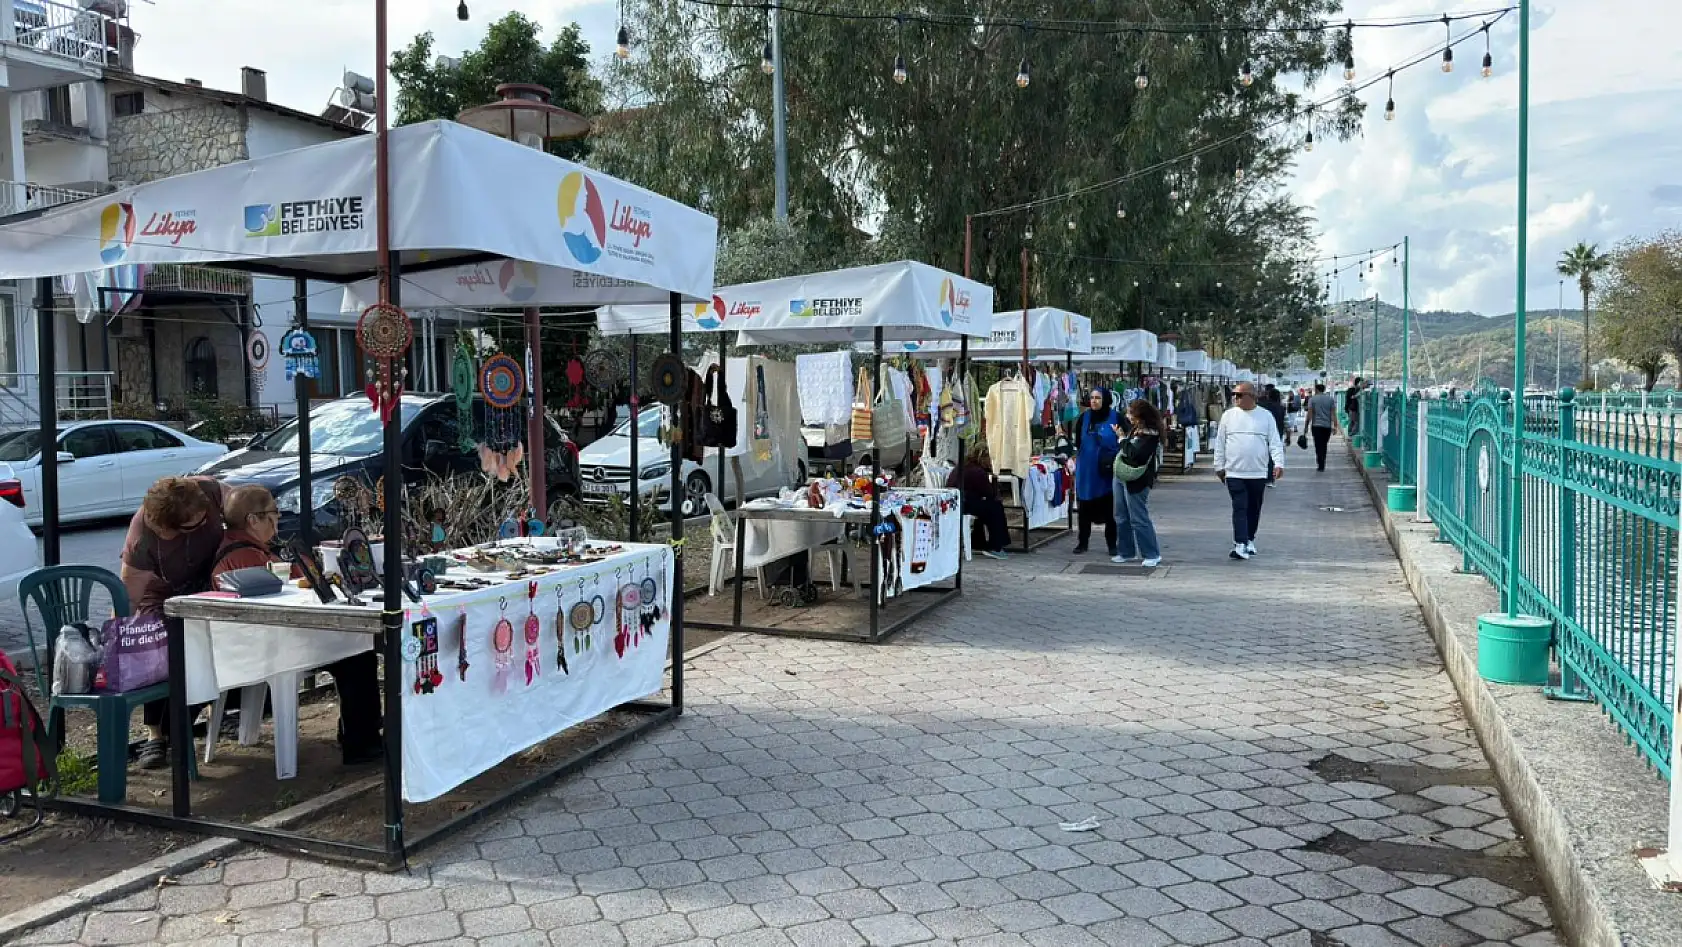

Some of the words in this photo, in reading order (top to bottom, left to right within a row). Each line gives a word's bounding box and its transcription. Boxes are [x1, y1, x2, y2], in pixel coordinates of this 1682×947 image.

[140, 212, 197, 245] Likya
[610, 199, 653, 248] Likya
[729, 300, 761, 319] Likya
